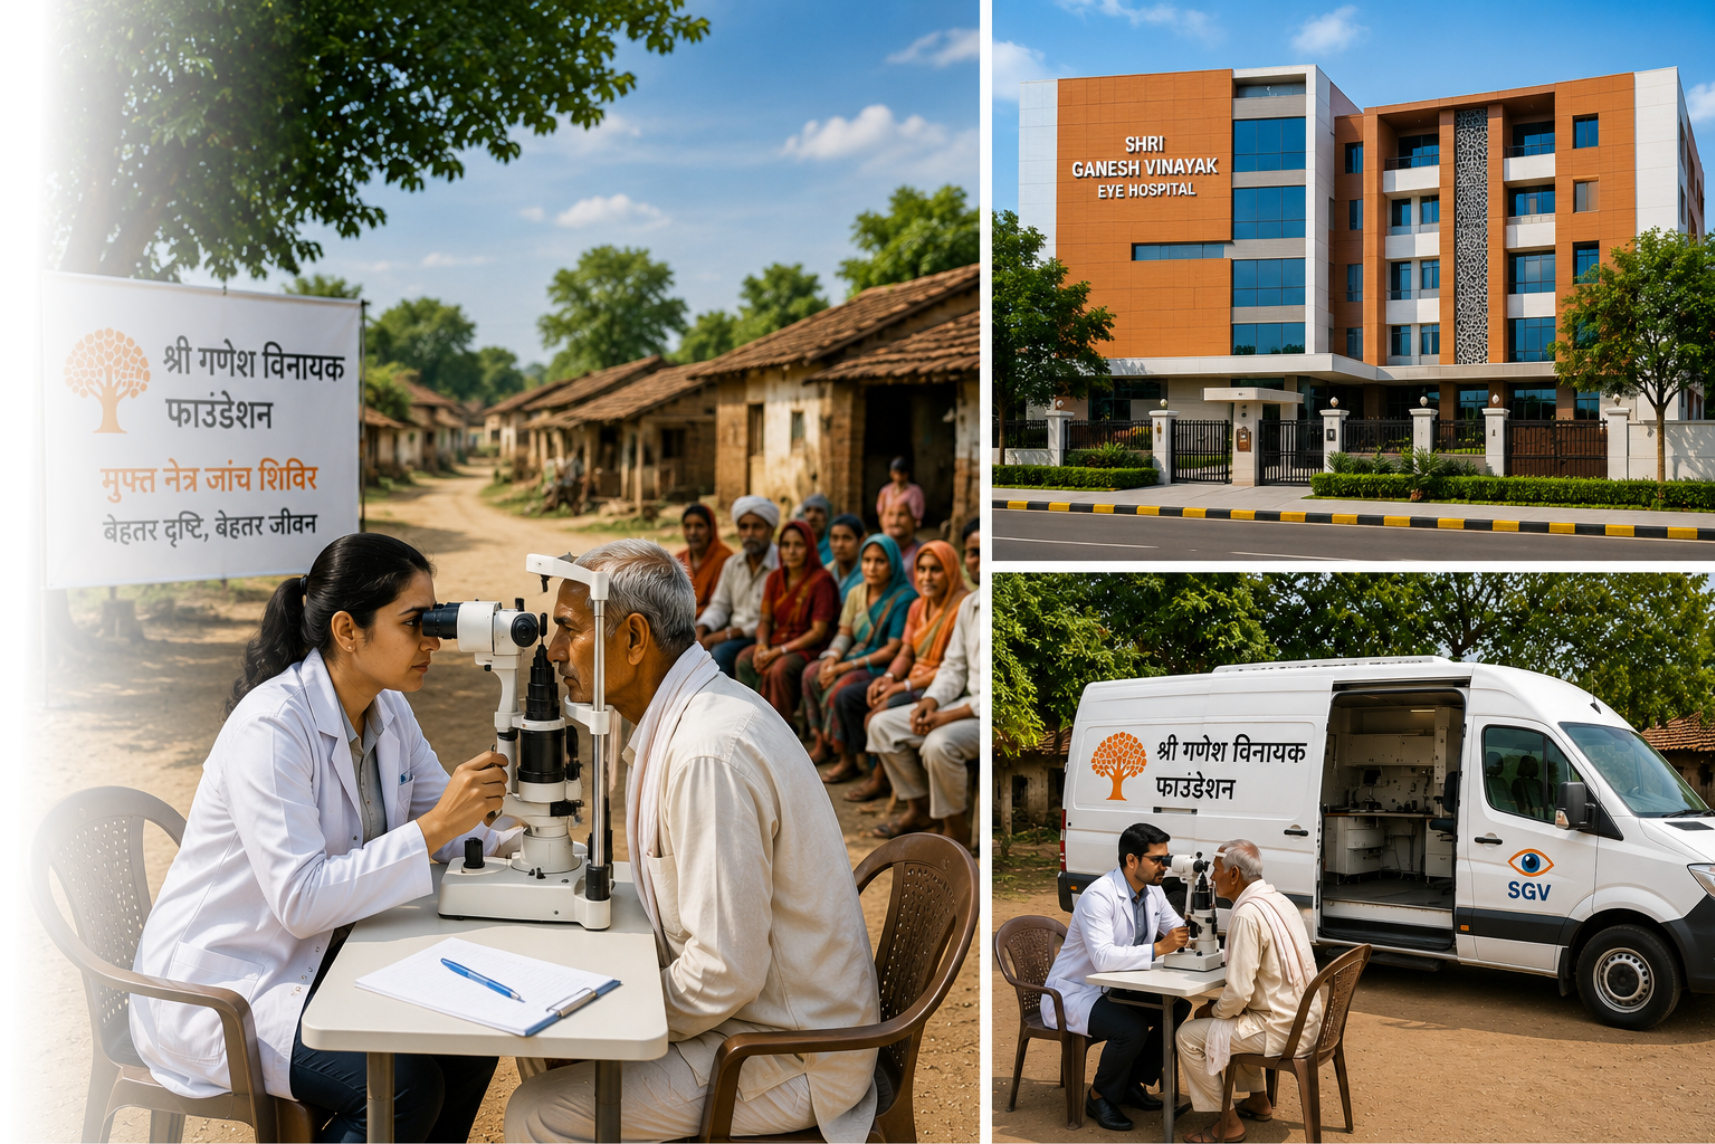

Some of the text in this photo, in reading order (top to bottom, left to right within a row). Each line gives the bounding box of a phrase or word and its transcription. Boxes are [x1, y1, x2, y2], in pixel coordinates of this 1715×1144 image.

[1125, 135, 1165, 153] SHRI
[1072, 157, 1218, 178] GANESH VINAYAK
[1098, 182, 1197, 199] EYE HOSPITAL
[162, 335, 345, 382] श्री गणेश विनायक
[165, 390, 273, 430] फाउंडेशन
[100, 457, 318, 504] मुफ्त नेत्र जांच शिविर
[102, 508, 318, 548] बेहतर दृष्टि, बेहतर जीवन
[1157, 733, 1307, 763] श्री गणेश विनायक
[1155, 771, 1236, 800] फाउंडेशन
[1507, 881, 1551, 901] SGV
